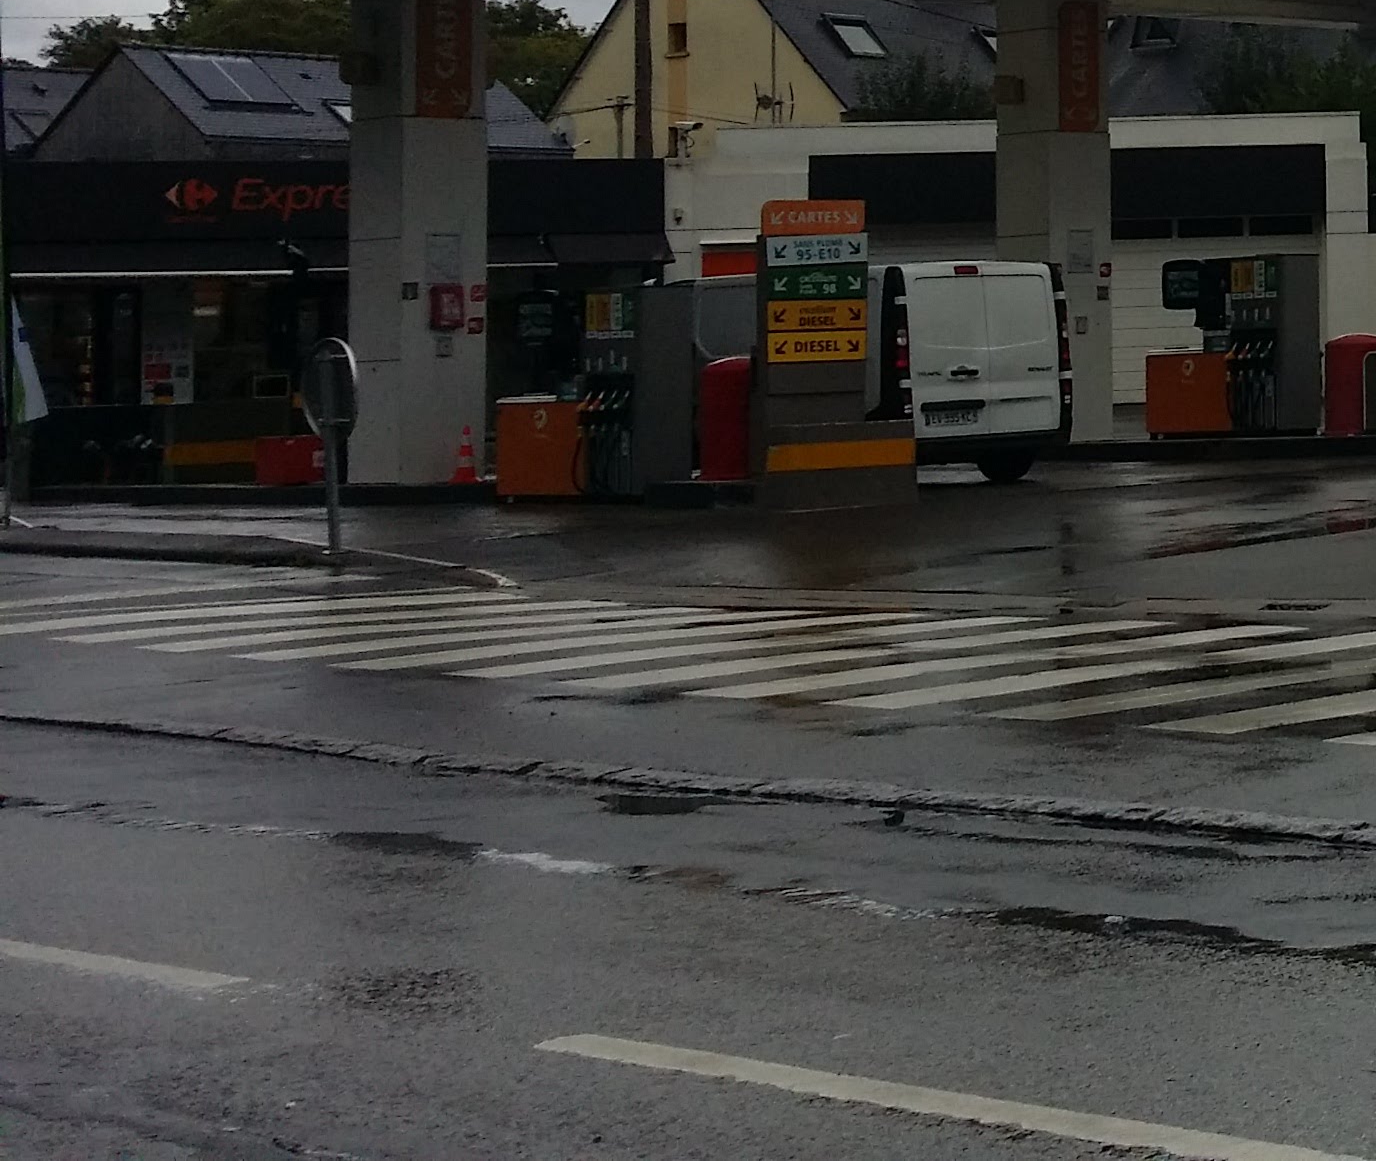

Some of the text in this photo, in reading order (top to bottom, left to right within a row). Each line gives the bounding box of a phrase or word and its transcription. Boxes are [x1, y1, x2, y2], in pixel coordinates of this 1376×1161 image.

[231, 177, 349, 223] Expre
[788, 211, 840, 224] CARTES
[796, 248, 840, 260] 95-E10
[799, 316, 837, 327] DIESEL
[794, 340, 840, 353] DIESEL
